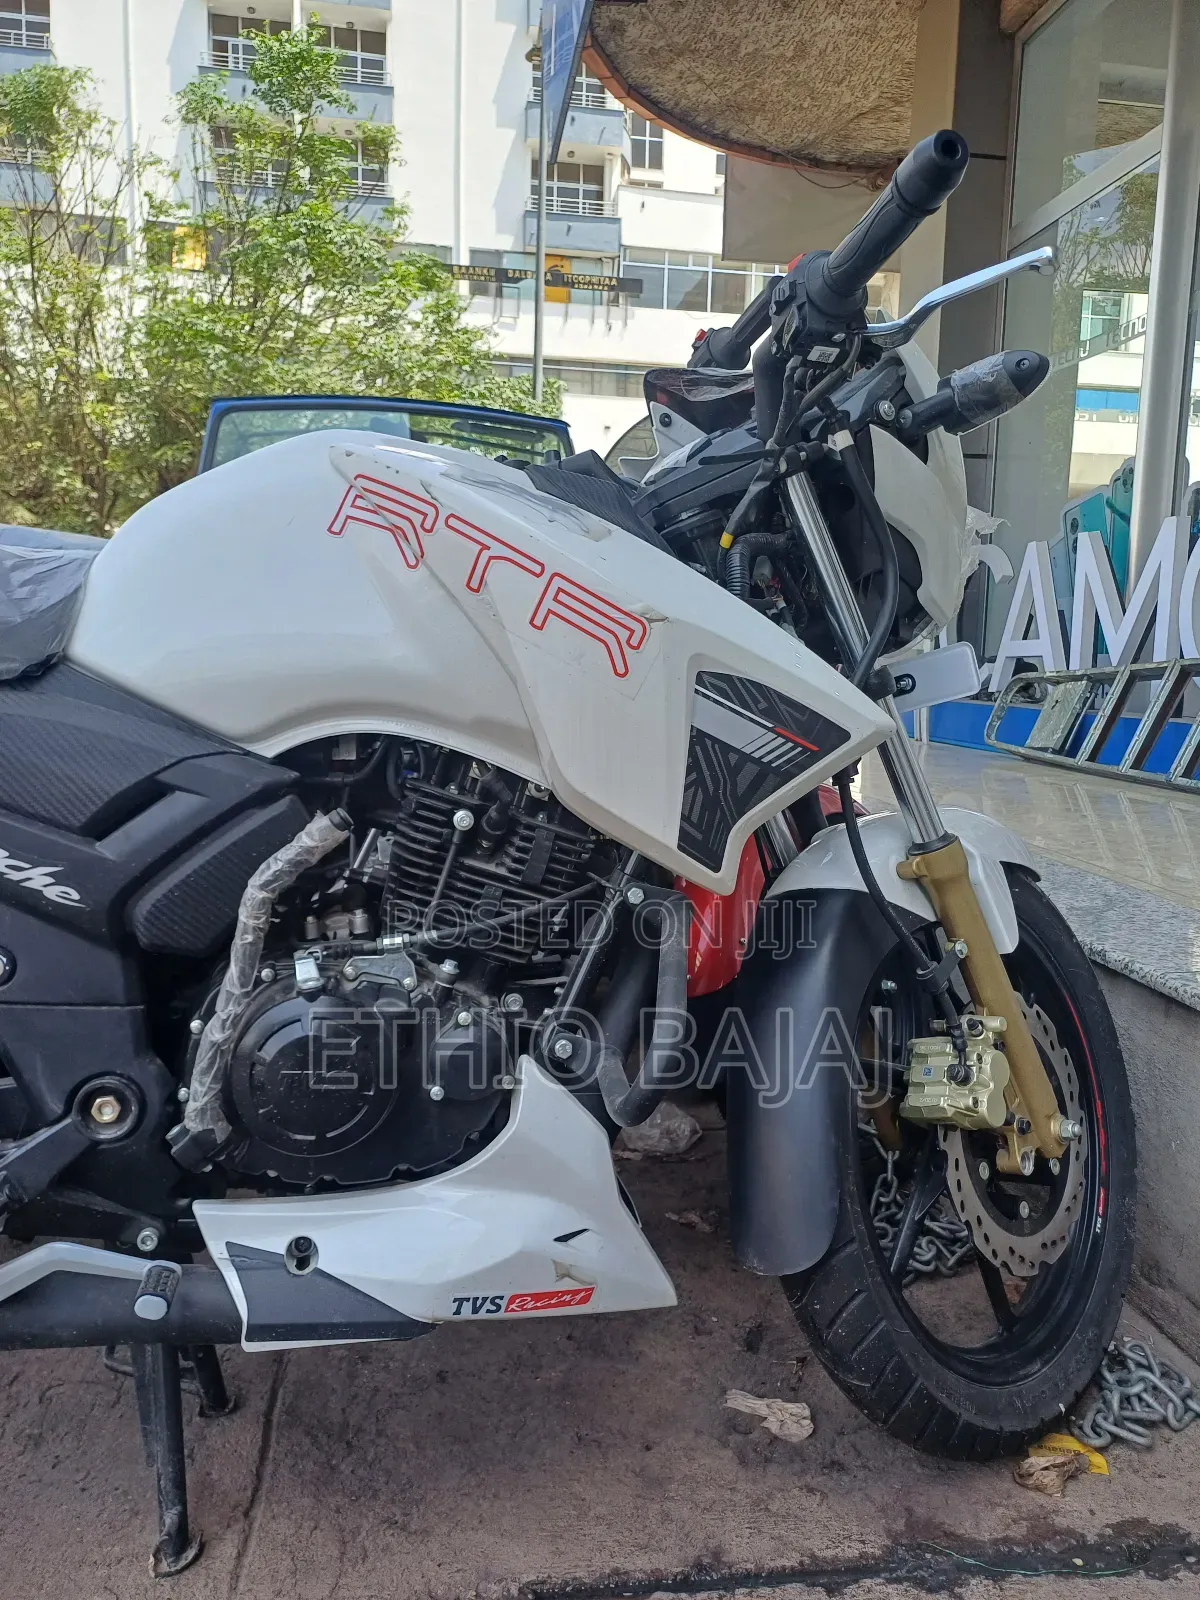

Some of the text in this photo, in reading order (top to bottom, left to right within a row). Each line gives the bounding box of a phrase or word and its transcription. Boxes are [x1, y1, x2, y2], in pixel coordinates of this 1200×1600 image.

[327, 473, 649, 678] RTR
[0, 847, 87, 907] che
[452, 1289, 593, 1316] TVS Racing
